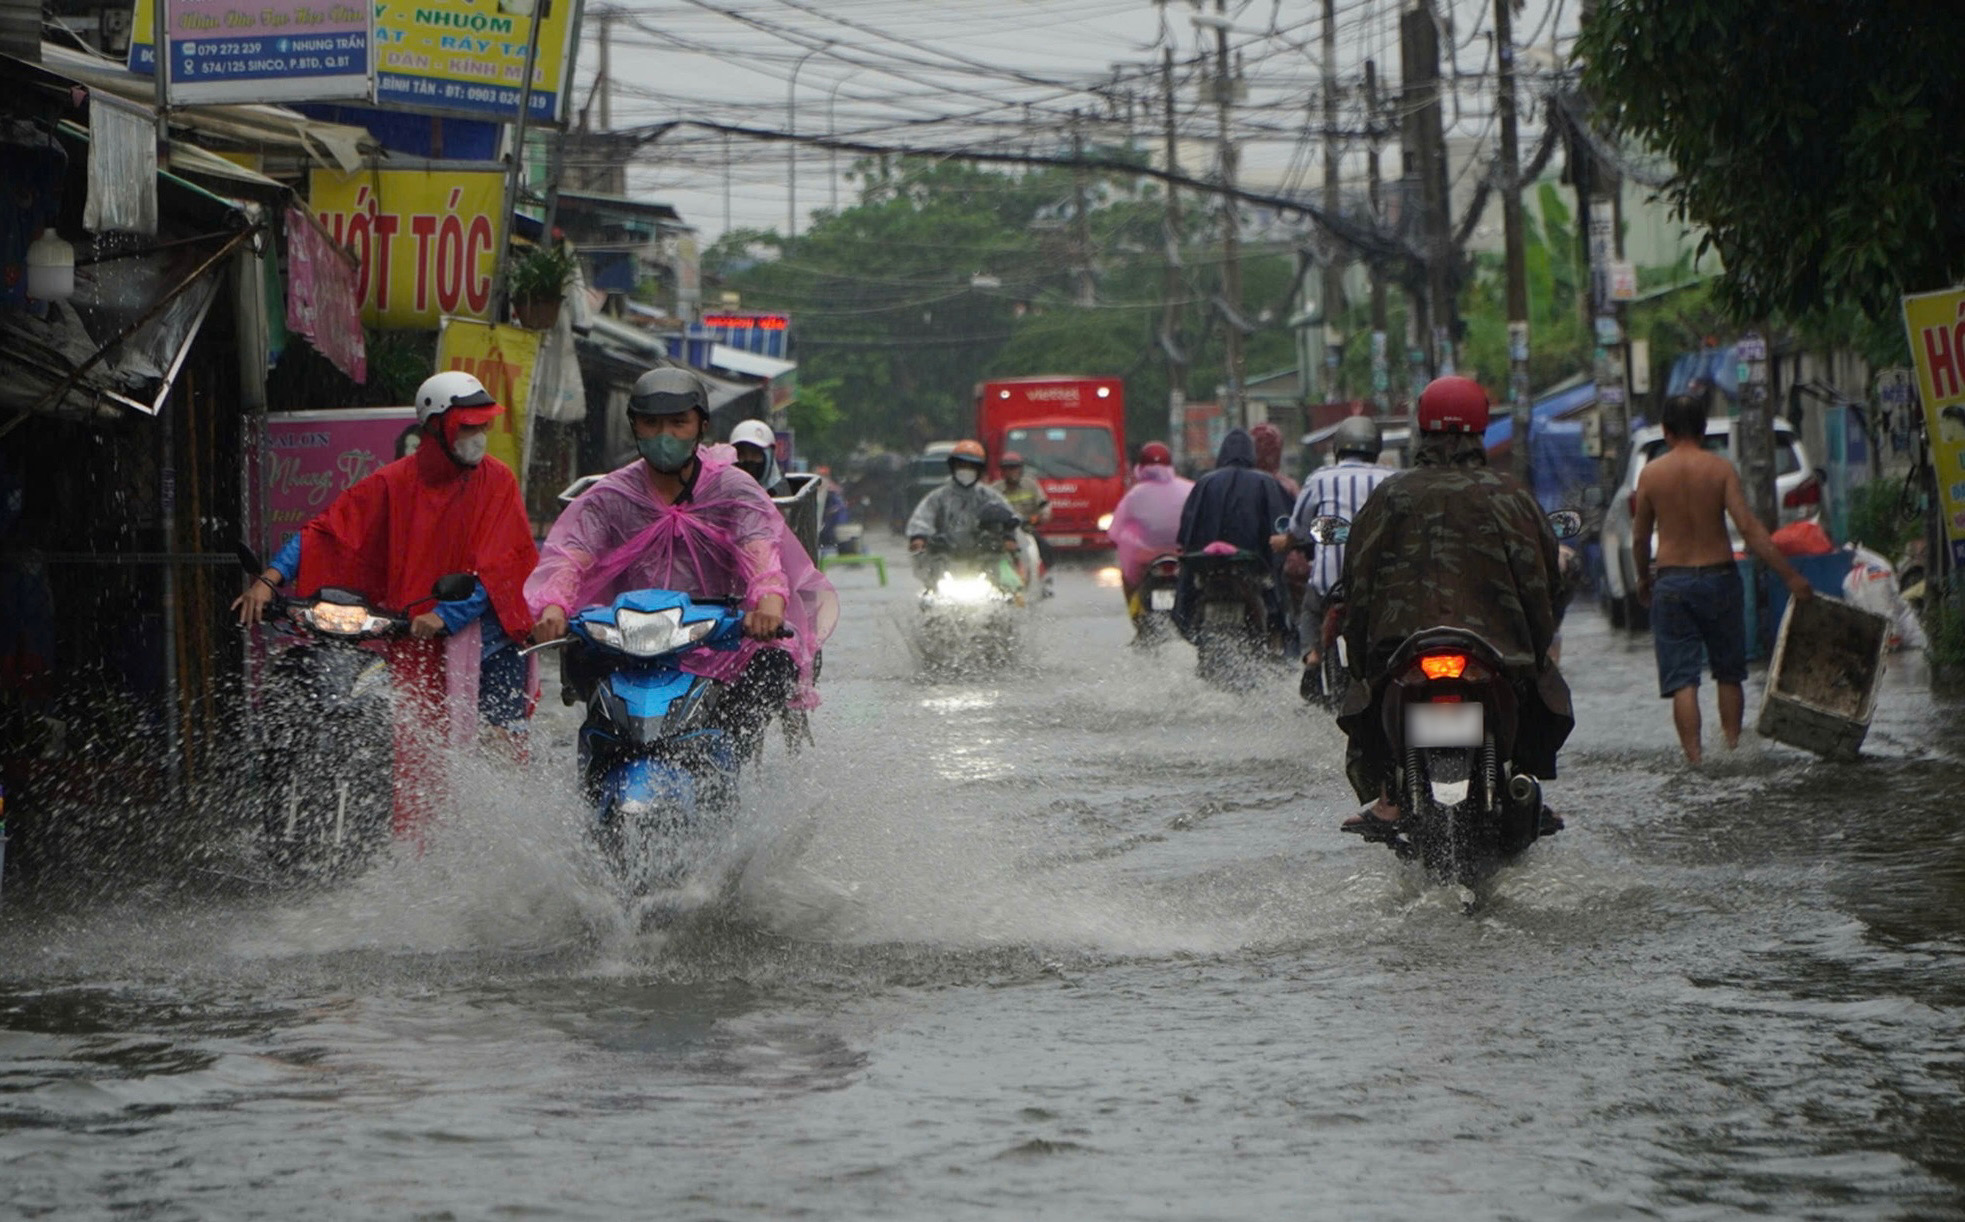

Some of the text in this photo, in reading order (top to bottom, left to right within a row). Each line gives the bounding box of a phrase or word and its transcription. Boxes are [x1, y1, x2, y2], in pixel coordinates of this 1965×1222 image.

[416, 9, 513, 33] NHUỘM
[198, 42, 262, 56] 079 272 239
[292, 40, 333, 51] NHUNG
[202, 61, 246, 73] 574/125
[450, 58, 498, 76] KÍNH
[504, 66, 543, 82] MI
[413, 80, 437, 96] TÂN
[467, 87, 497, 103] 0903
[319, 186, 493, 314] ỚT TÓC
